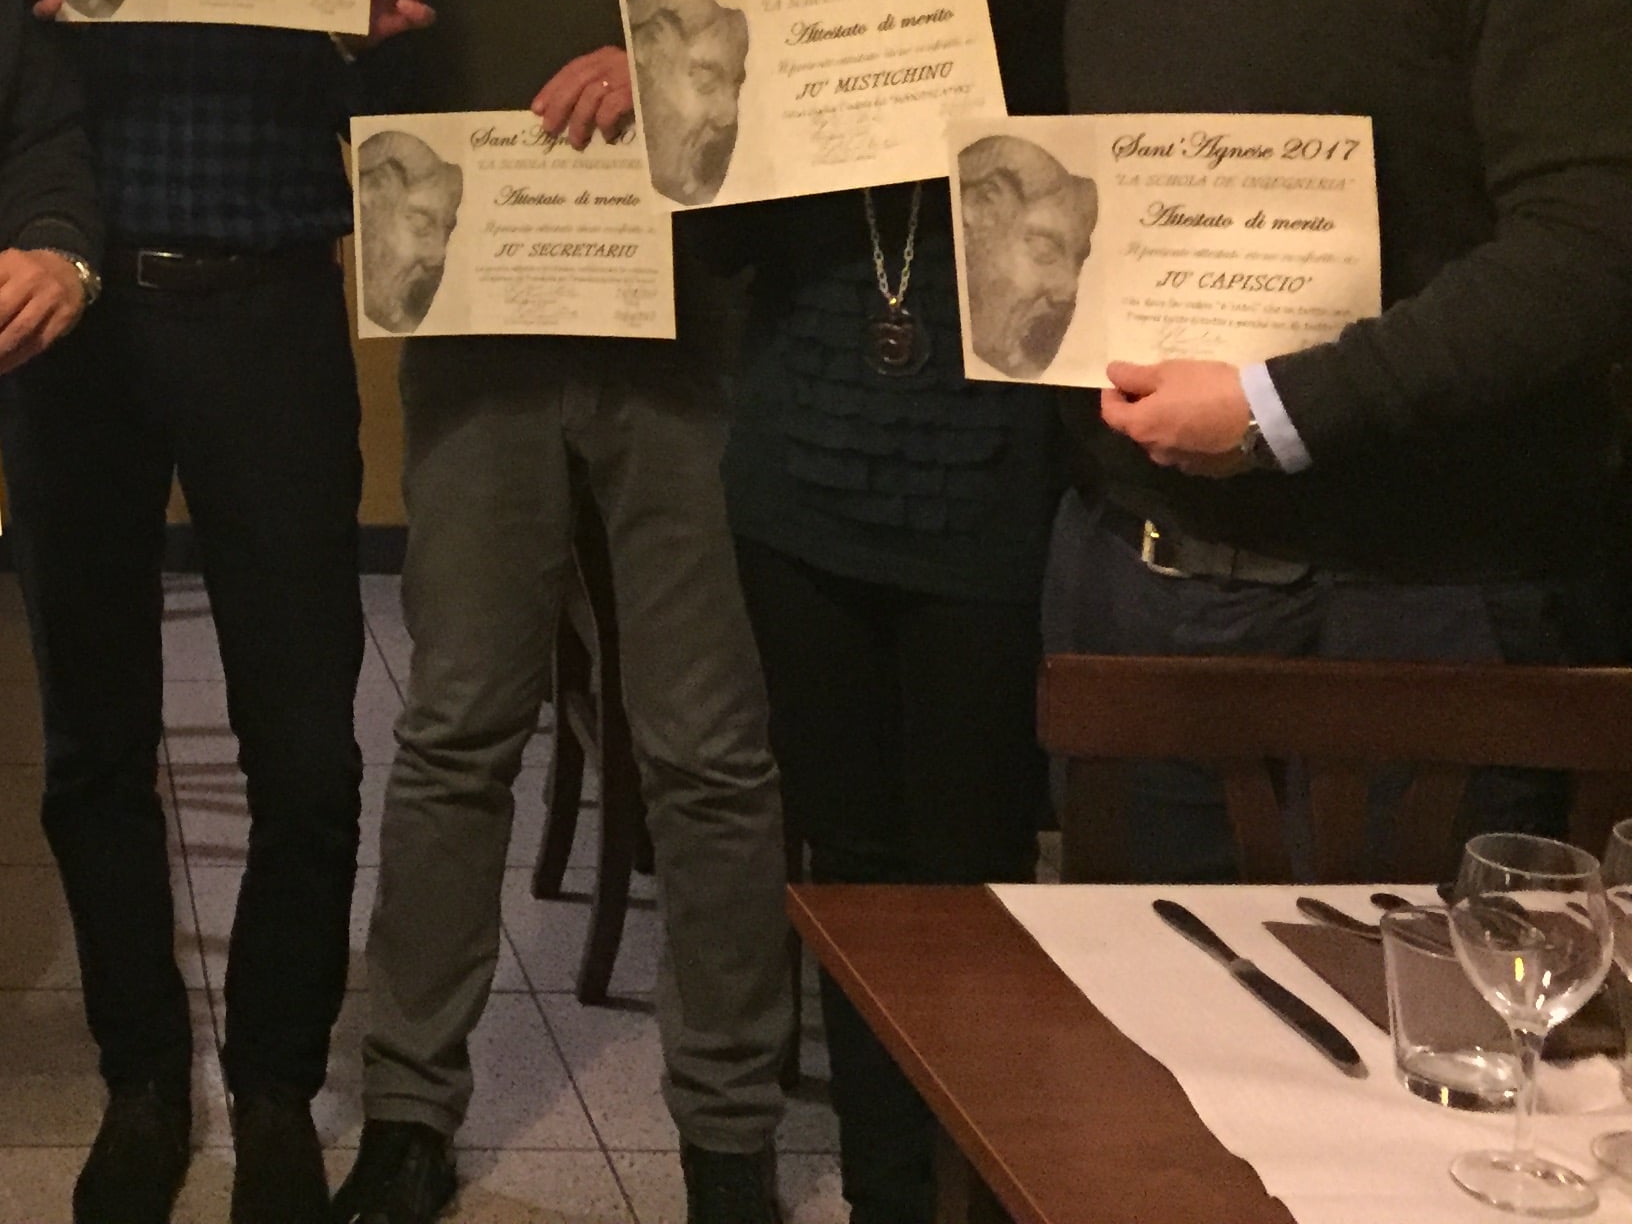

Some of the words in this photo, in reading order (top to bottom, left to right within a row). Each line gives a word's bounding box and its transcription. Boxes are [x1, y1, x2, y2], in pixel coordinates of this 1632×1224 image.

[784, 21, 868, 45] Attestato
[877, 14, 896, 32] di
[901, 8, 954, 28] merito
[795, 80, 829, 100] JU'
[834, 61, 954, 94] MISTICHINU
[470, 126, 570, 153] Sant'Agn
[1112, 132, 1274, 170] Sant'Agnese
[1281, 138, 1360, 160] 2017
[494, 185, 567, 206] Attestato
[574, 190, 590, 205] di
[594, 194, 640, 206] merito
[1139, 202, 1234, 228] Attestato
[1245, 210, 1266, 229] di
[1271, 217, 1334, 231] merito
[494, 243, 525, 258] JU'
[528, 242, 639, 258] SECRETARIU
[1156, 271, 1194, 288] JU'
[1198, 272, 1312, 293] CAPISCIO'
